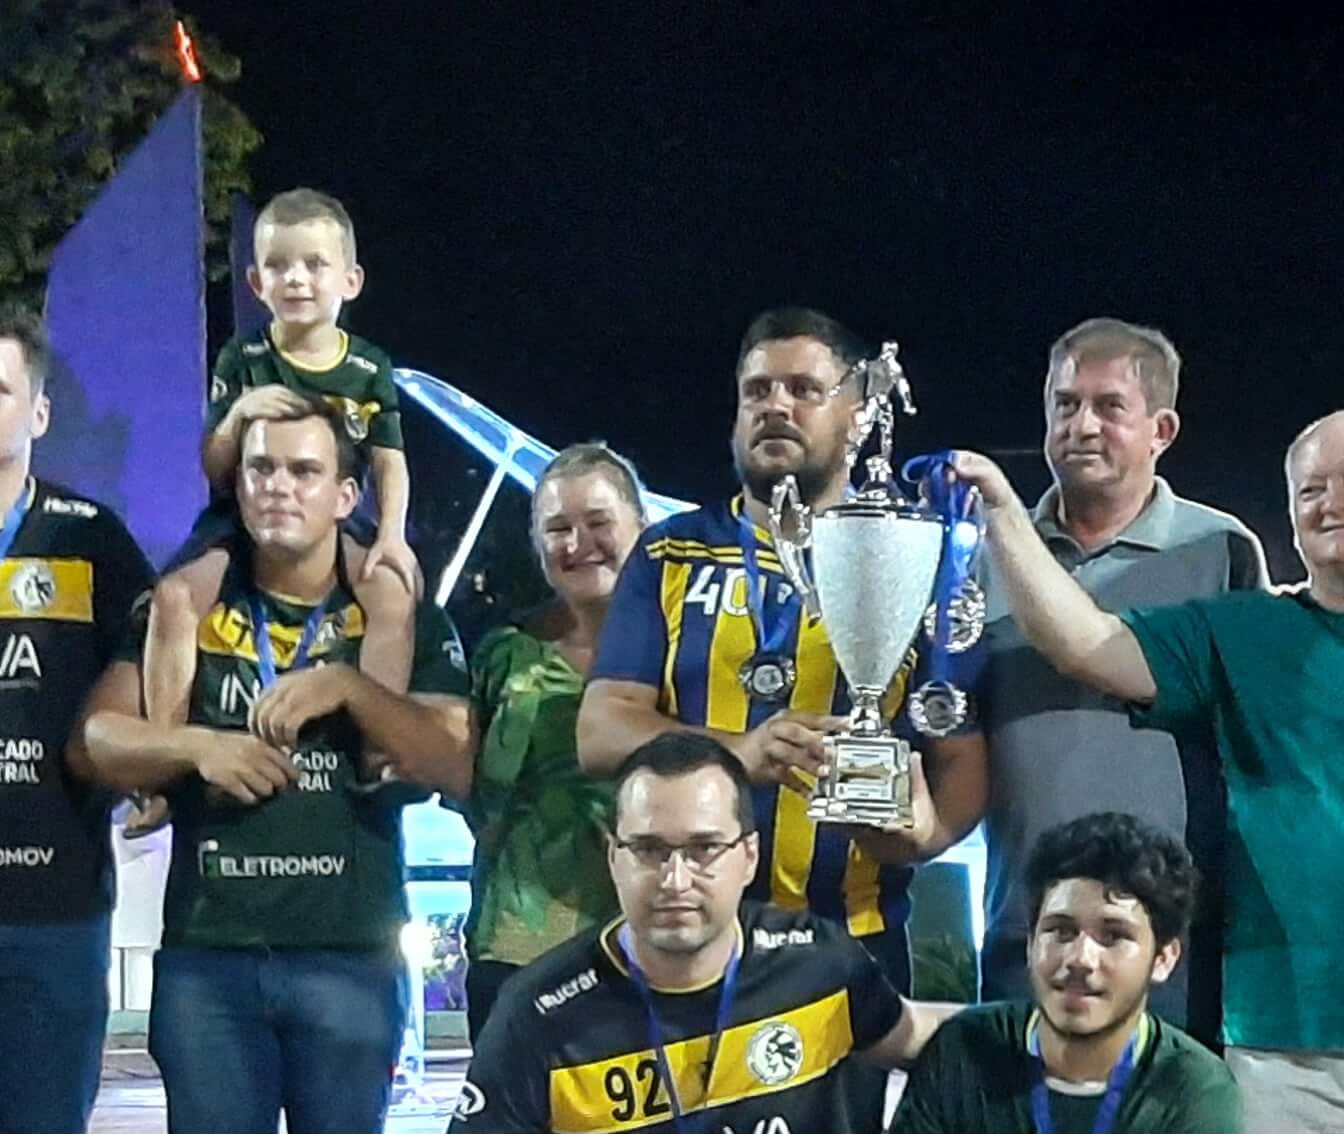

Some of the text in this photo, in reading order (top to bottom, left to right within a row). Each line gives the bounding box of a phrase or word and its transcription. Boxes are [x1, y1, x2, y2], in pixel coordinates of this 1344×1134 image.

[685, 565, 749, 616] 40
[219, 855, 346, 877] ELETROMOV
[605, 1059, 670, 1122] 92
